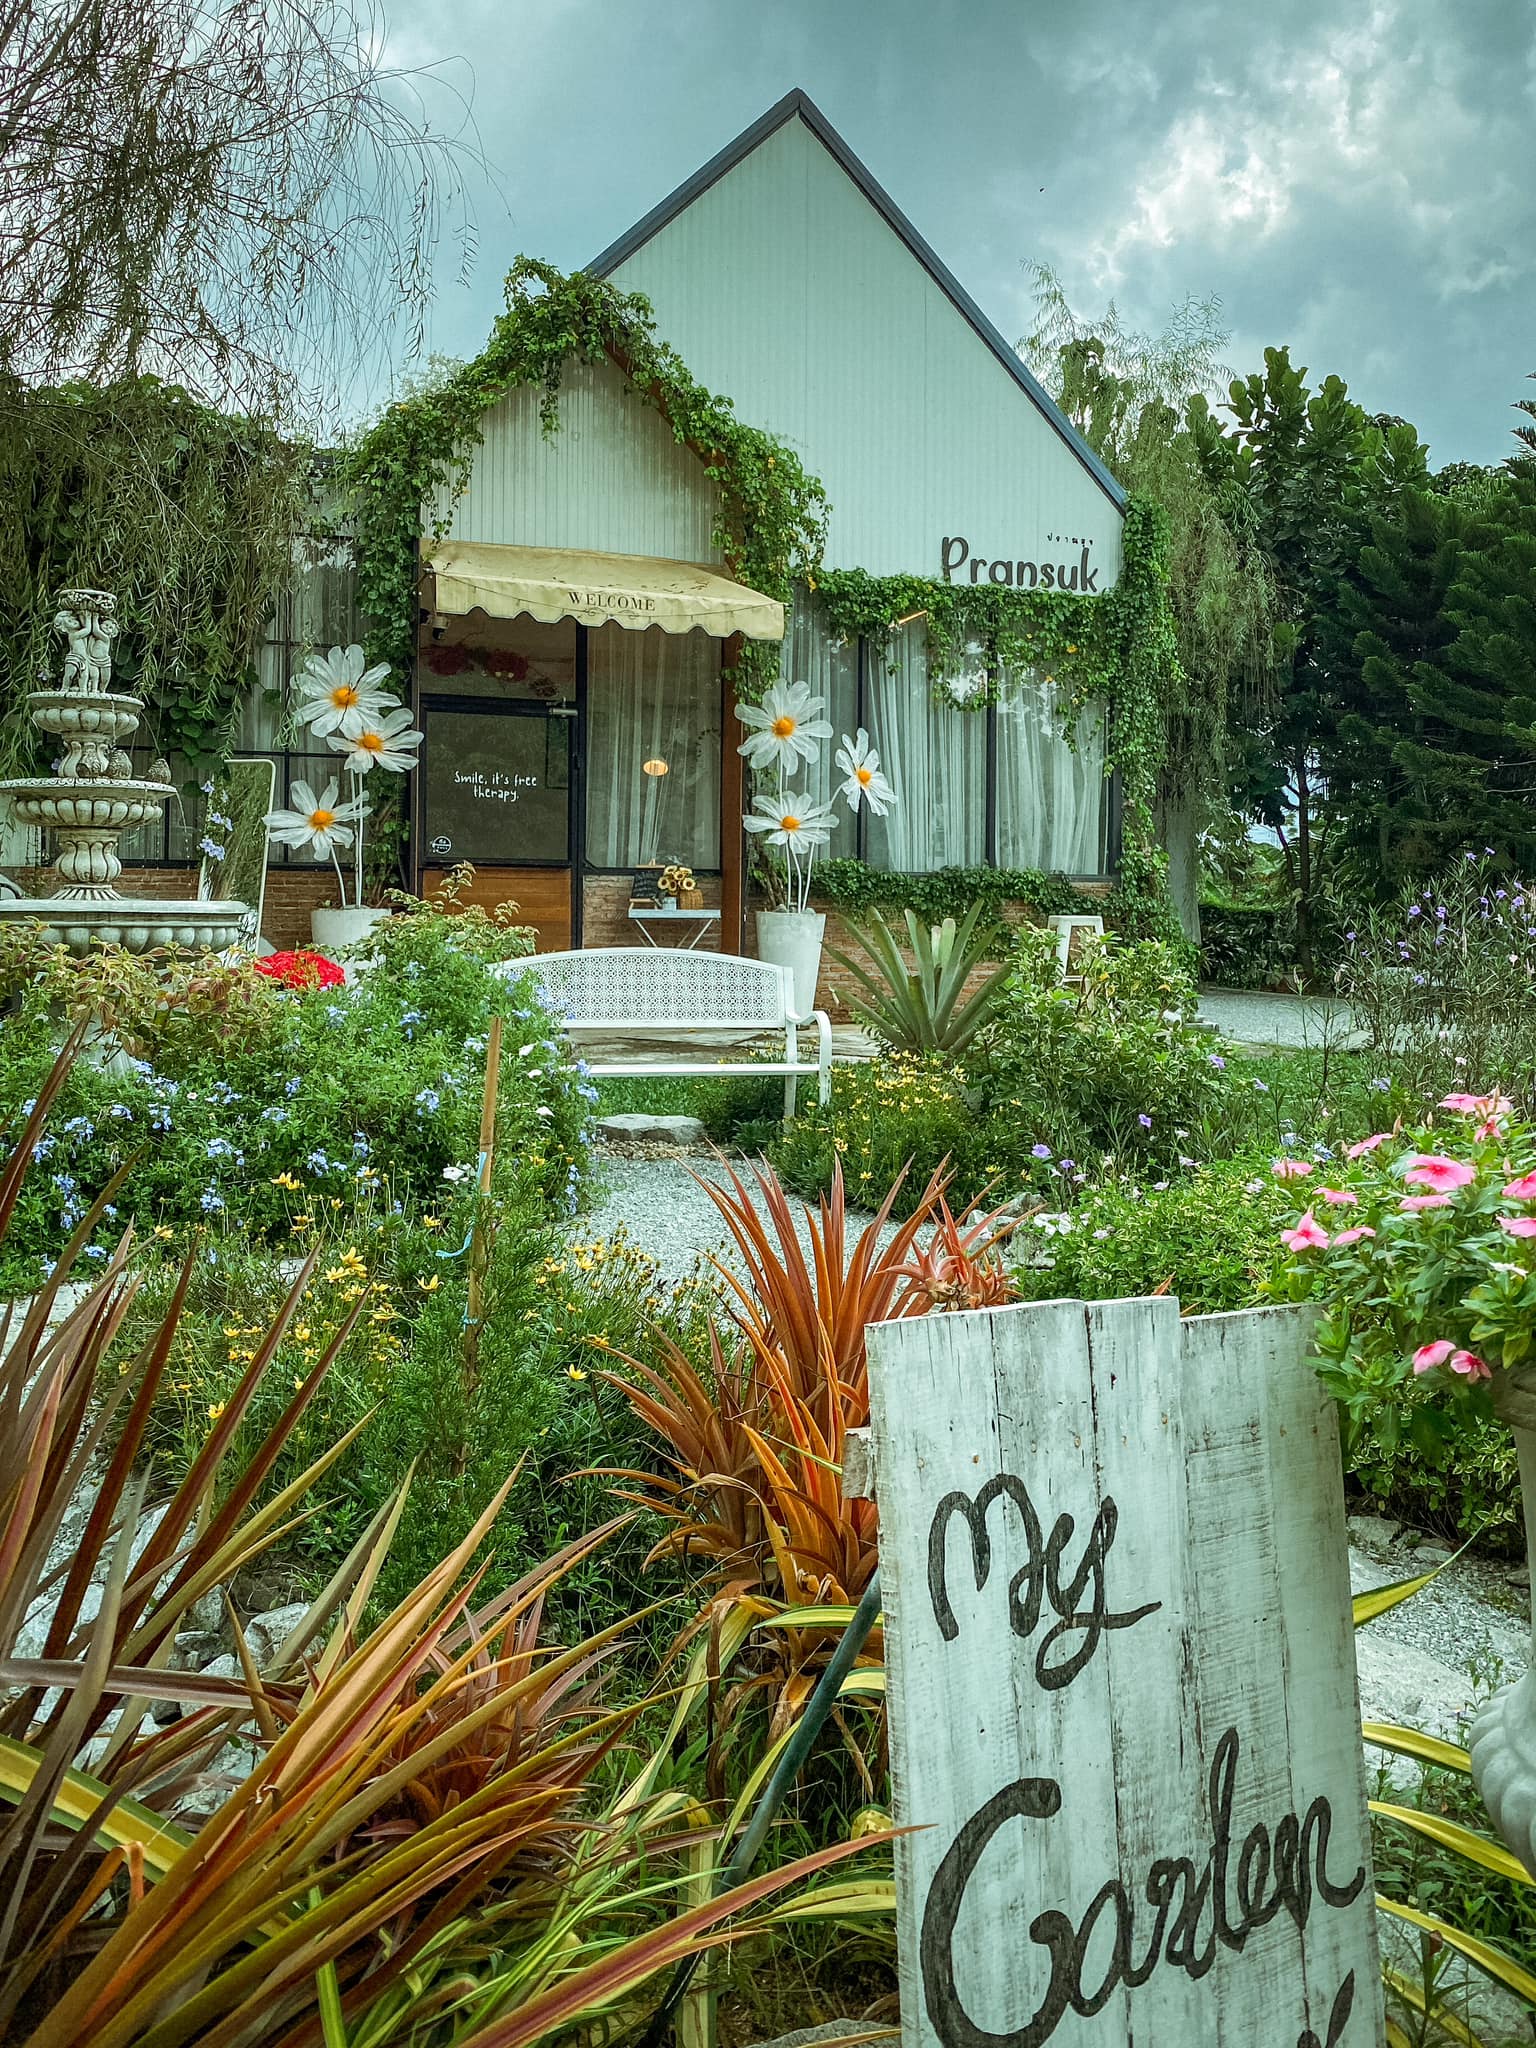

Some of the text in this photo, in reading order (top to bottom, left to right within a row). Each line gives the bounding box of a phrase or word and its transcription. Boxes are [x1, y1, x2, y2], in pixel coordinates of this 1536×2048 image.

[942, 537, 1098, 592] Pransuk
[568, 592, 655, 611] WELCOME
[454, 770, 537, 787] Smile, it's free
[928, 1474, 1162, 1690] My
[920, 1727, 1365, 2047] Garden
